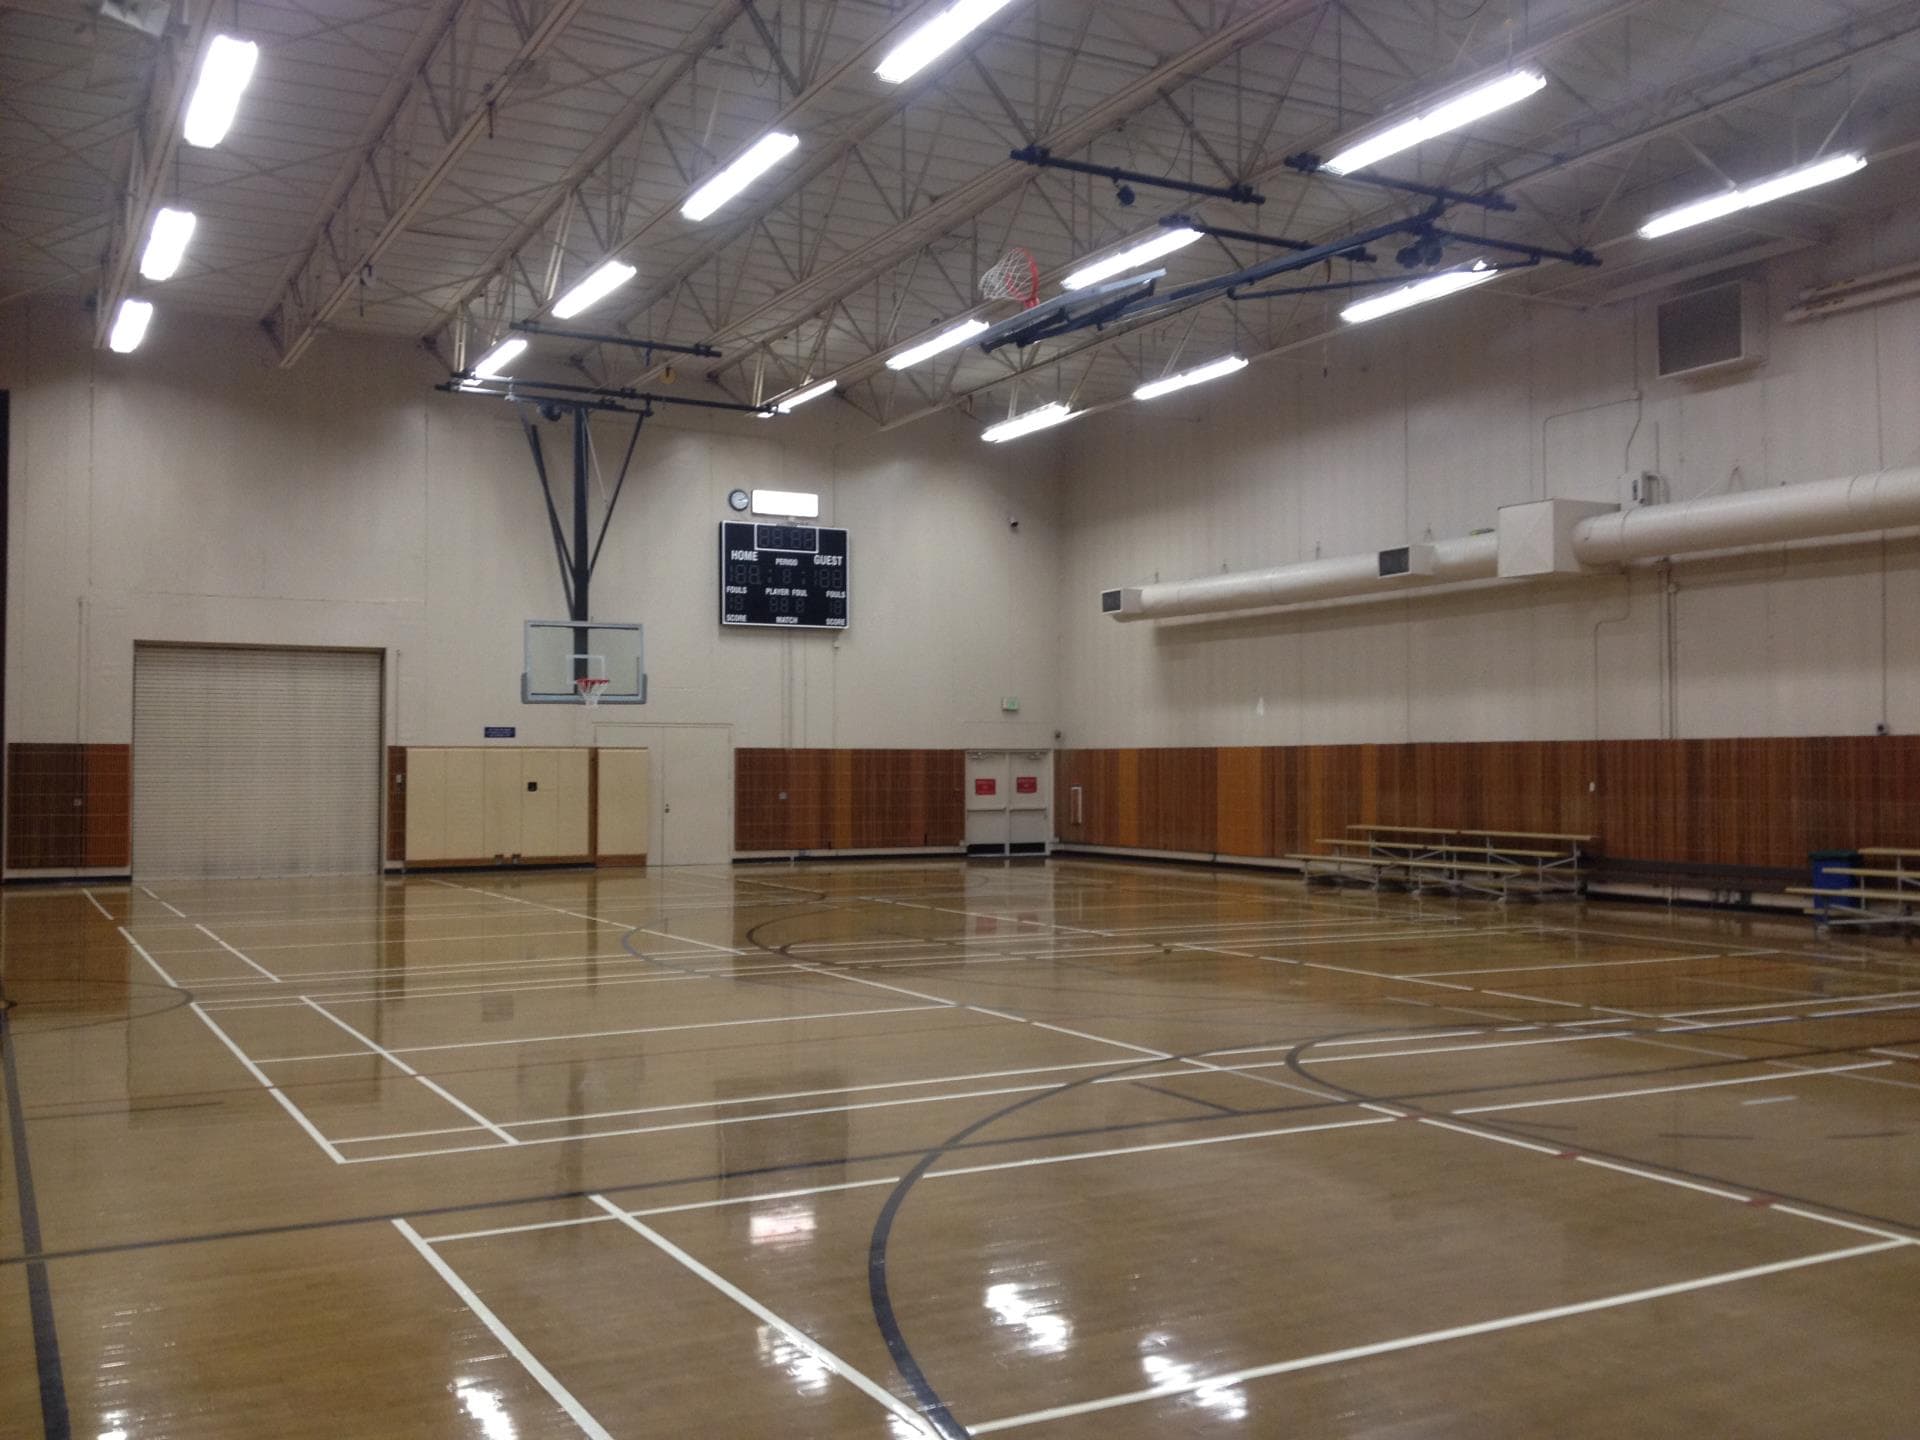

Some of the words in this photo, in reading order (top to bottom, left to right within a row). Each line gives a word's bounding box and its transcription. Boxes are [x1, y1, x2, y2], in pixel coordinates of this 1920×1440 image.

[731, 550, 758, 561] HOME
[775, 558, 798, 566] PERIOD
[814, 555, 842, 566] GUEST
[726, 586, 748, 594] FOULS
[765, 587, 790, 596] PLAYER
[792, 589, 808, 597] FOUL
[826, 590, 846, 598] FOULS
[726, 614, 747, 622] SCORE
[776, 616, 798, 624] MATCH
[826, 618, 846, 626] SCORE
